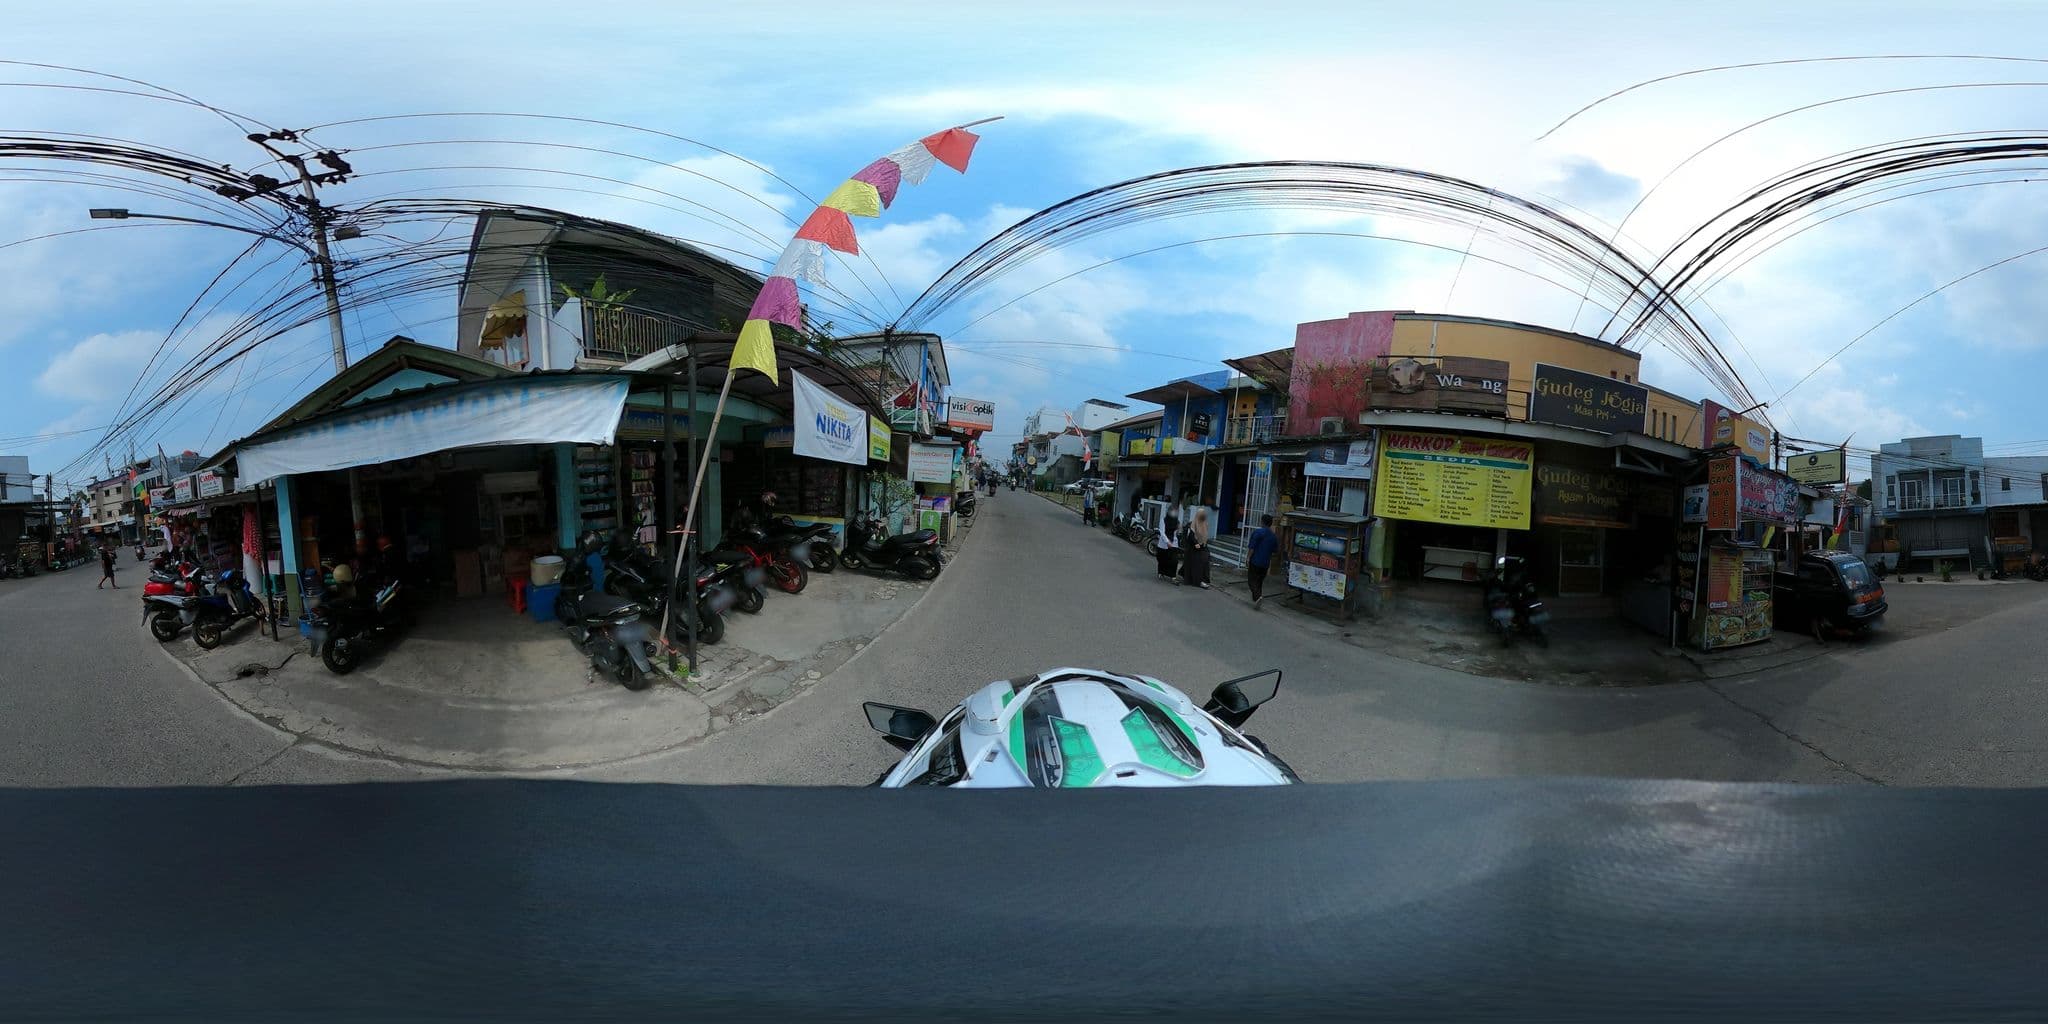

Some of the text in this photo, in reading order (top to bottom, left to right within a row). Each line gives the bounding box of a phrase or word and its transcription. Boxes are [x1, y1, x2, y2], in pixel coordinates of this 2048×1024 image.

[1535, 377, 1645, 416] Gudeg Jogja
[952, 401, 993, 416] visi optik
[816, 412, 852, 443] NIKITA
[1388, 433, 1453, 450] WARKOP
[1424, 455, 1480, 464] SEDIA
